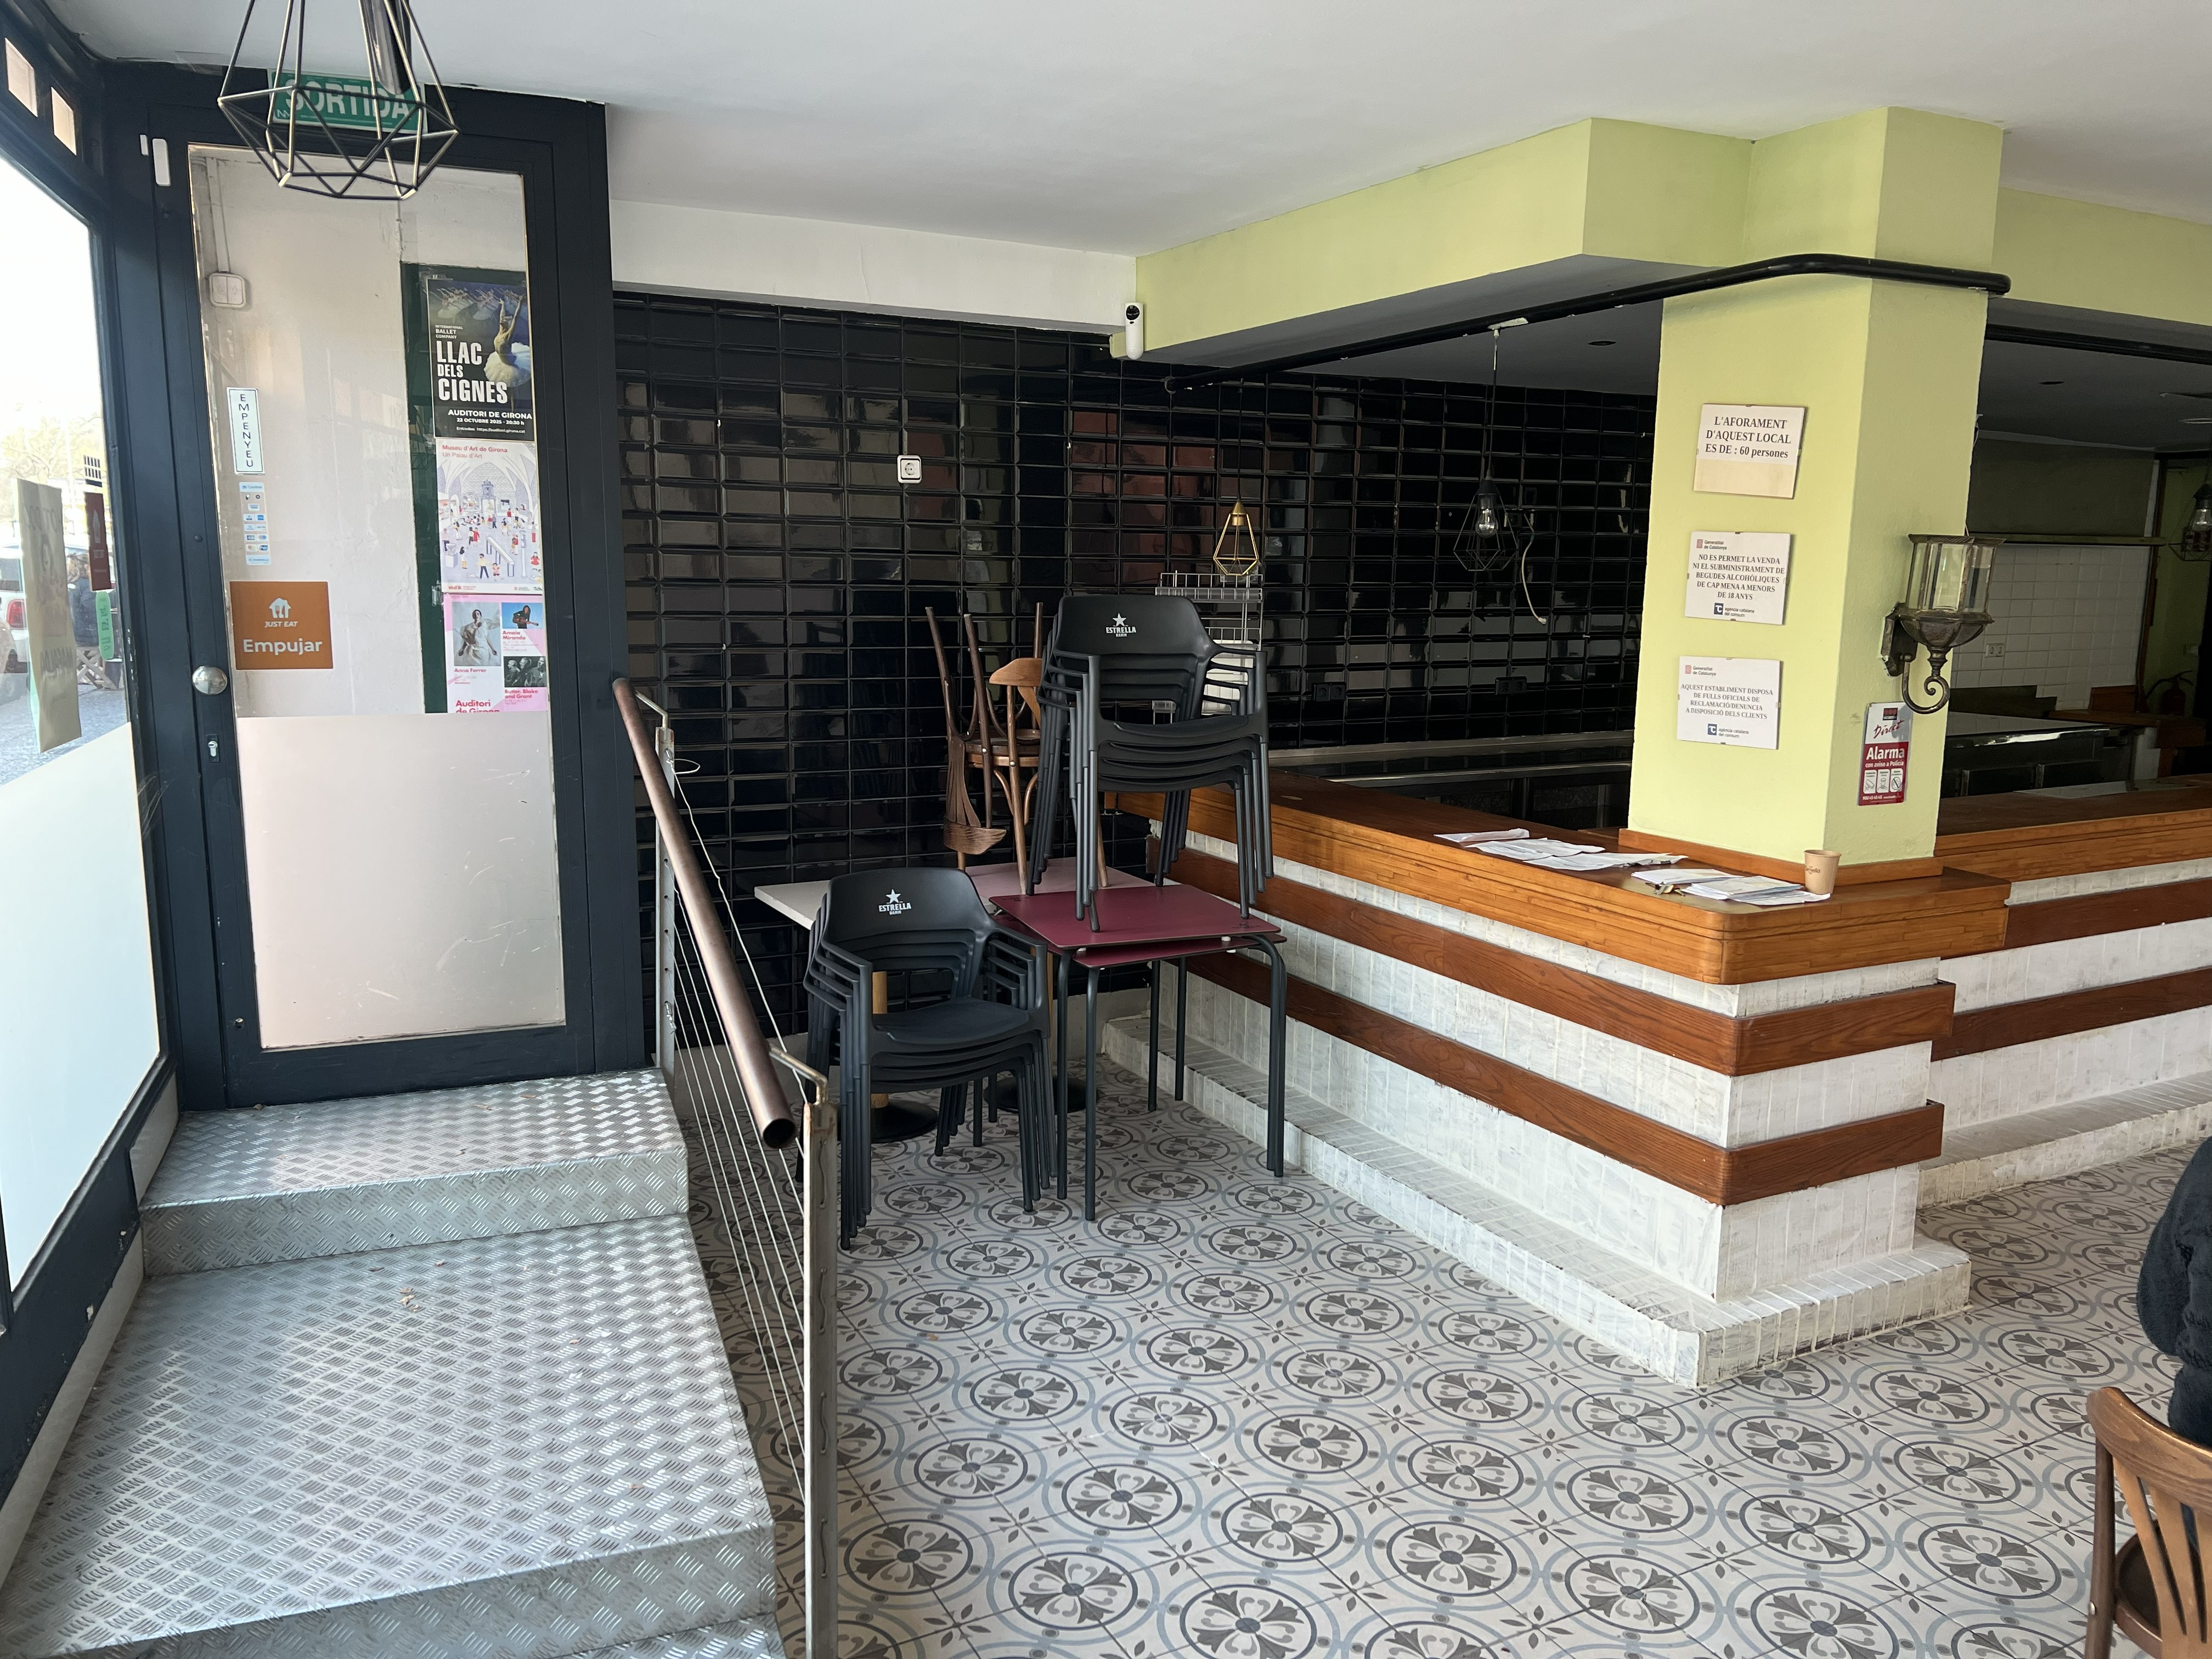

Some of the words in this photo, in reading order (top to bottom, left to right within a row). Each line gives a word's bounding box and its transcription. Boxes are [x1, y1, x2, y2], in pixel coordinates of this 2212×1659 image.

[285, 78, 410, 119] SORTIDA
[436, 340, 482, 365] LLAC
[437, 364, 464, 377] DELS
[438, 378, 508, 404] CIGNES
[1714, 416, 1787, 429] L'AFORAMENT
[238, 393, 253, 467] EMPENYEU
[1706, 430, 1755, 441] D'AQUEST
[1756, 433, 1791, 444] LOCAL
[1705, 443, 1717, 453] ES
[1719, 444, 1732, 454] DE
[1740, 446, 1750, 455] 60
[1751, 448, 1788, 458] persones
[1710, 563, 1774, 574] SUBMINISTRAMENT
[1696, 572, 1725, 580] BEGUDES
[1726, 572, 1780, 583] ALCOHÒLIQUES
[243, 638, 323, 656] Empujar
[1705, 685, 1746, 693] ESTABLIMENT
[1691, 707, 1724, 716] DISPOSICIÓ
[1866, 746, 1905, 760] Alarma
[878, 902, 911, 912] ESTRELLA
